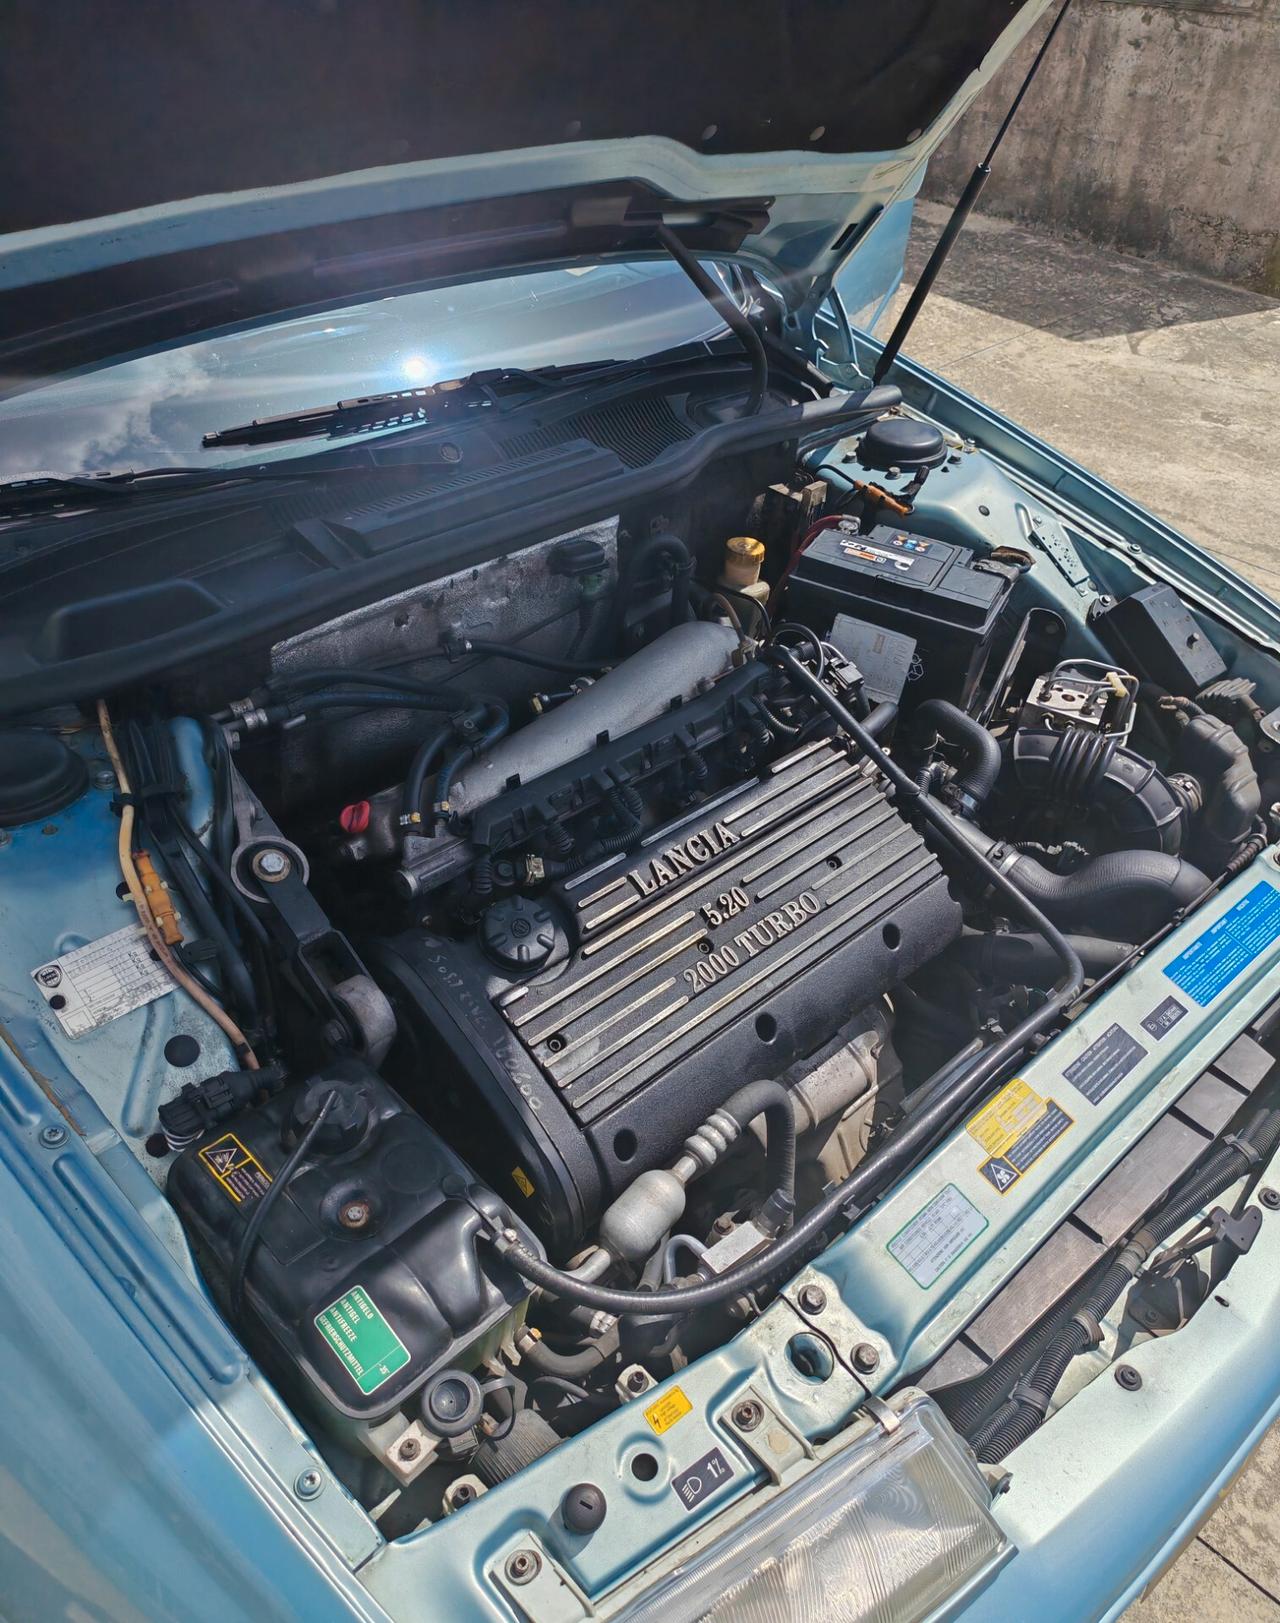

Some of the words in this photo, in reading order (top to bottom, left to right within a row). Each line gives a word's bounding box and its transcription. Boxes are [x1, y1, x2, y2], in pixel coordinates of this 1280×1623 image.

[628, 822, 740, 895] LANCIA
[701, 887, 750, 926] 5.20
[683, 945, 740, 993] 2000
[734, 892, 821, 957] TURBO
[340, 1298, 361, 1325] ANTIGEL
[350, 1290, 375, 1320] ANTIGELO
[329, 1306, 358, 1342] ANTIFREEZE
